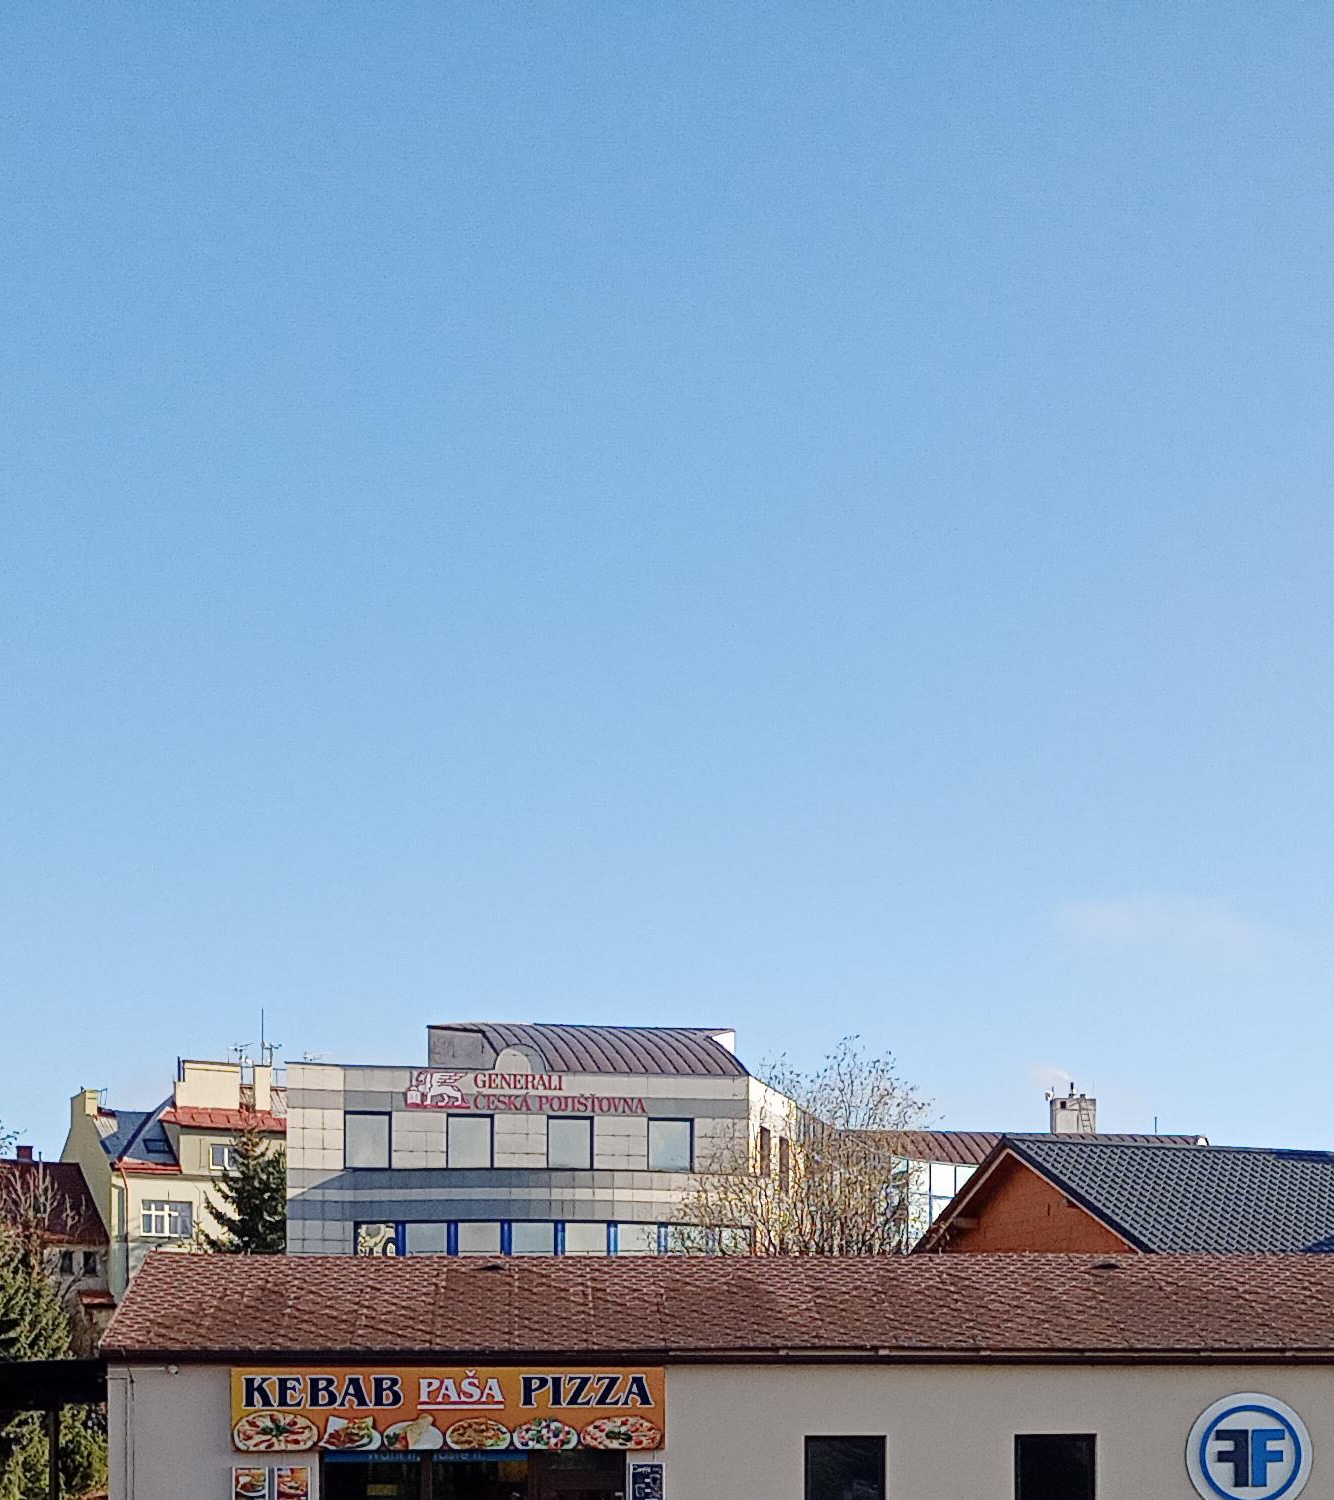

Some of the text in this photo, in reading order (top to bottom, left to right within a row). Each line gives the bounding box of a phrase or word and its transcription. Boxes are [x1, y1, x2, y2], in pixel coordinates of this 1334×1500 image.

[474, 1073, 563, 1091] GENERALI
[474, 1092, 648, 1114] ČESKÁ POJIŠŤOVNA
[242, 1370, 655, 1408] KEBAB PAŠA PIZZA
